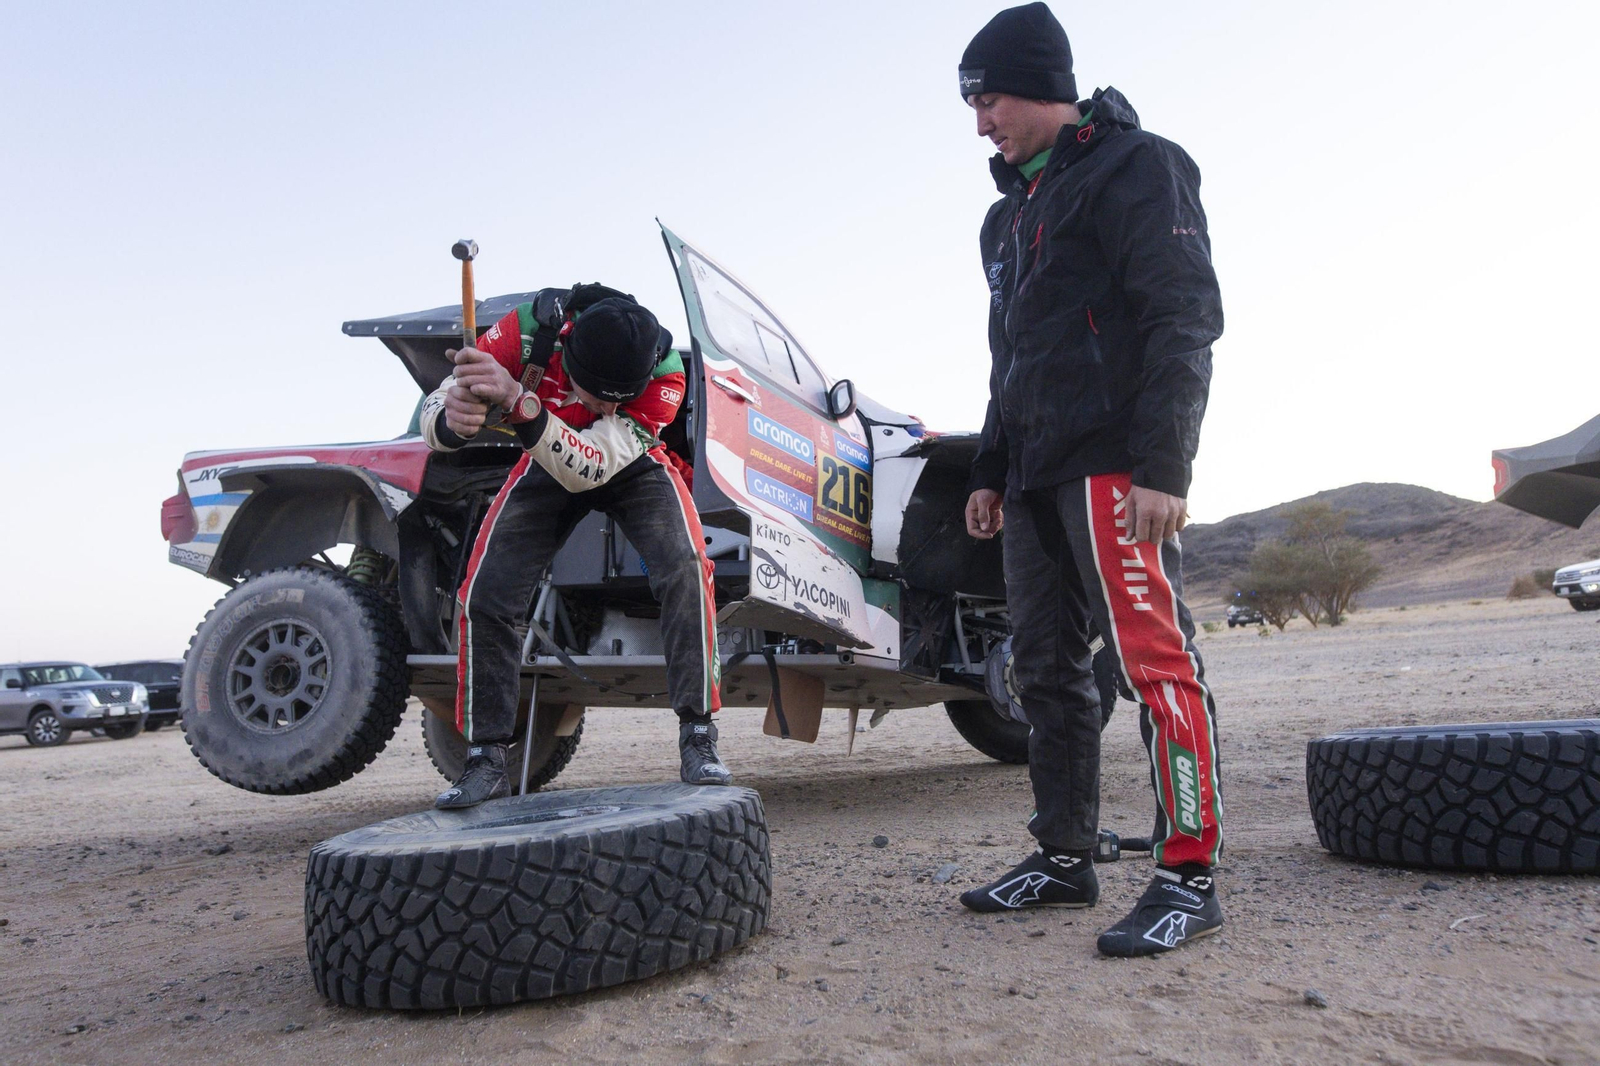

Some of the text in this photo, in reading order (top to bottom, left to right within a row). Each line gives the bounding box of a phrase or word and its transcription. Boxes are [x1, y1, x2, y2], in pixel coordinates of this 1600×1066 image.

[489, 324, 500, 340] MP
[660, 388, 681, 404] OMP
[753, 417, 810, 458] aramco
[836, 440, 869, 465] aramco
[750, 448, 774, 465] DREAM.
[774, 460, 793, 474] DARE.
[793, 468, 806, 480] LIVE
[821, 456, 870, 525] 216
[816, 513, 838, 529] DREAM.
[838, 523, 854, 536] DARE.
[854, 530, 865, 541] LIVE
[170, 546, 211, 564] EUROCAR
[791, 575, 851, 618] YACOPINI
[1175, 755, 1198, 831] PUMA
[1199, 760, 1211, 828] ENERGY
